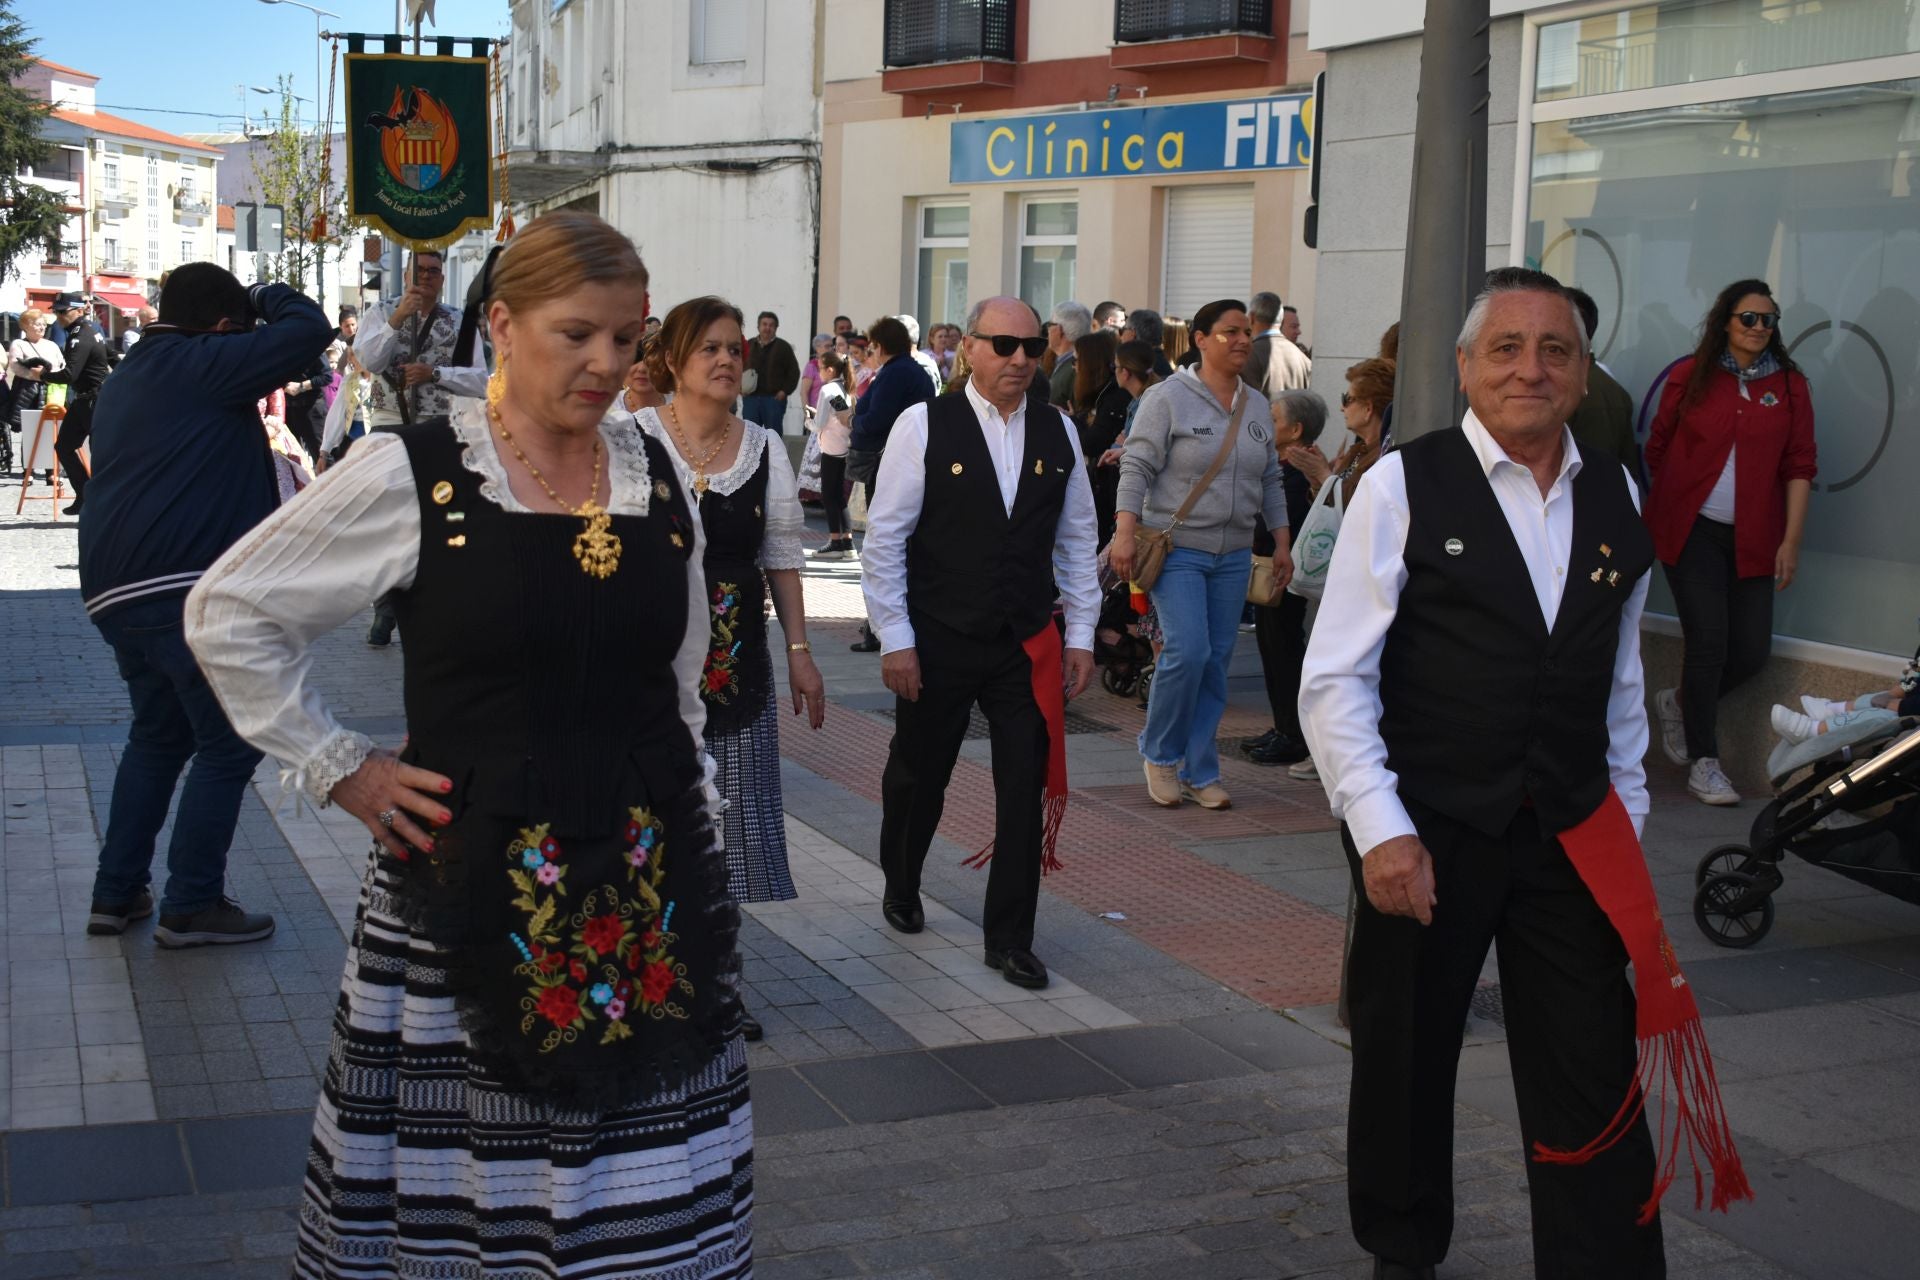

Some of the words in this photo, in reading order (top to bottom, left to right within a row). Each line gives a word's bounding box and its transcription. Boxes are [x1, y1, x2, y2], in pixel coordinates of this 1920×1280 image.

[986, 119, 1184, 176] Clínica
[375, 189, 393, 206] Junta
[393, 201, 412, 215] Local
[413, 207, 438, 217] Fallera
[440, 203, 448, 213] de
